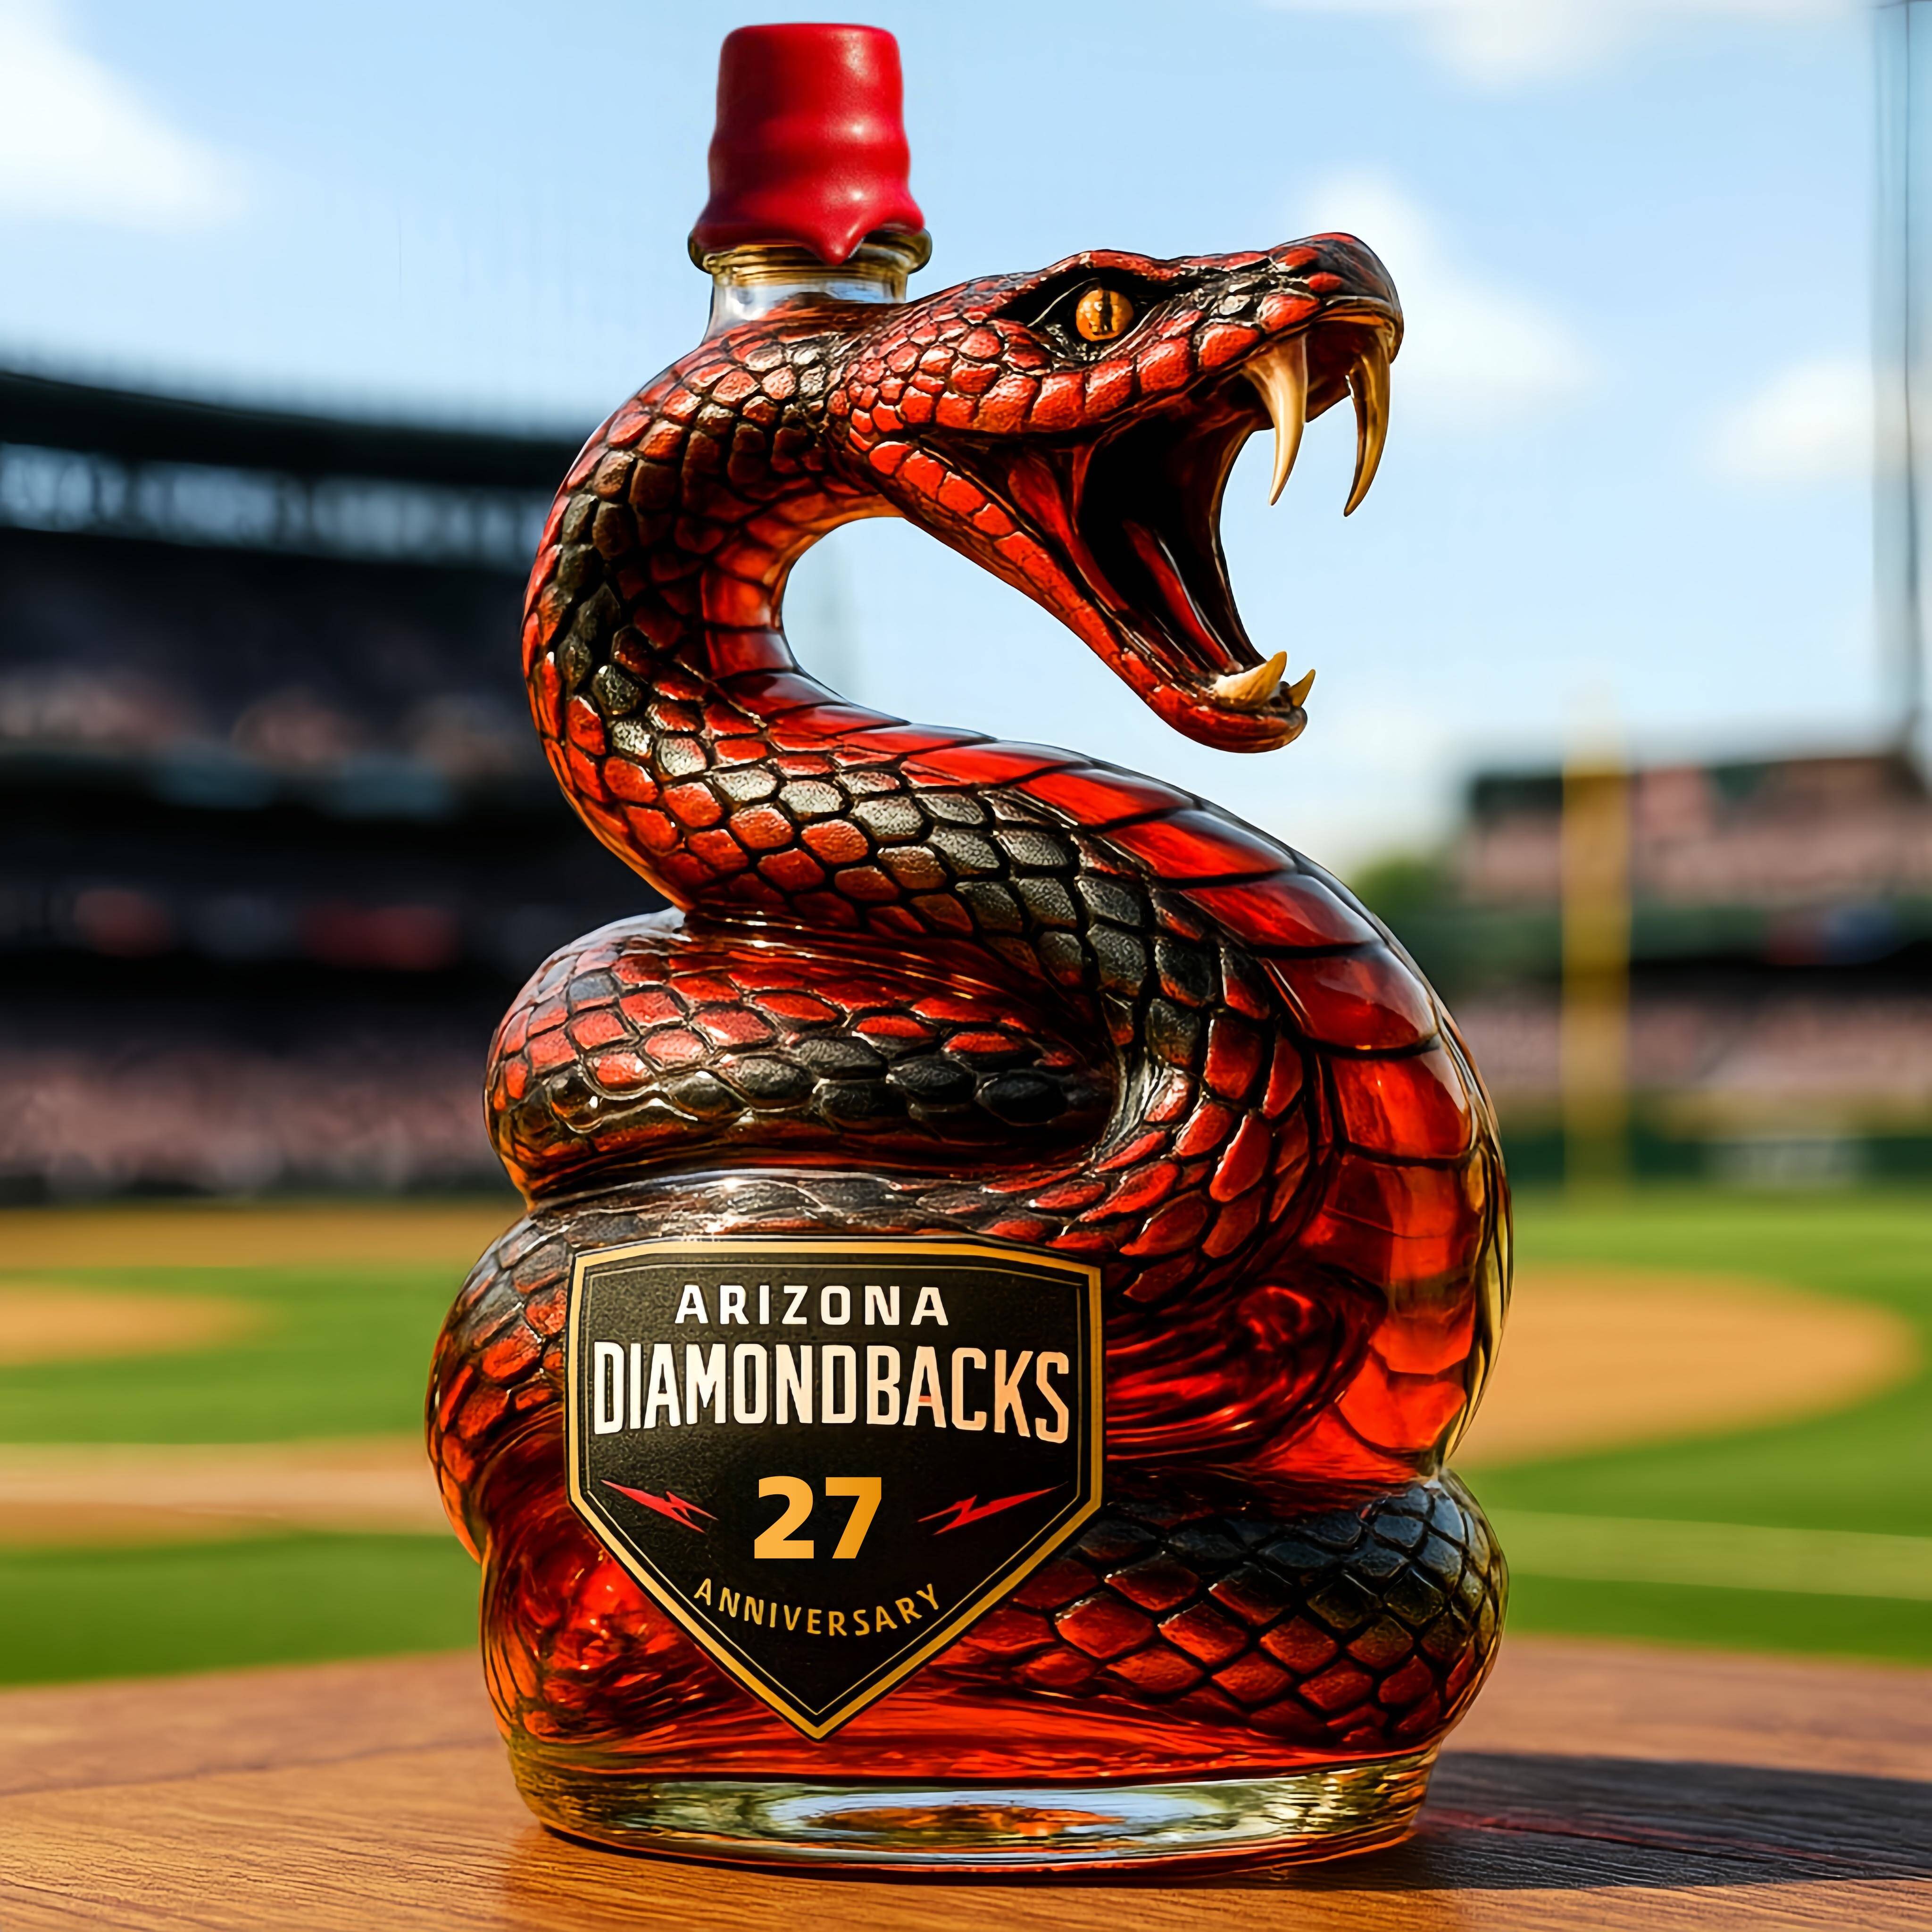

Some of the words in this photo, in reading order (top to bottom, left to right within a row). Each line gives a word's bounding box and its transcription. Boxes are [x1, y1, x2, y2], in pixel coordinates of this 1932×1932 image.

[675, 1284, 949, 1326] ARIZONA
[593, 1341, 1070, 1443] DIAMONDBACKS
[754, 1475, 882, 1559] 27
[694, 1578, 941, 1636] ANNIVERSARY
